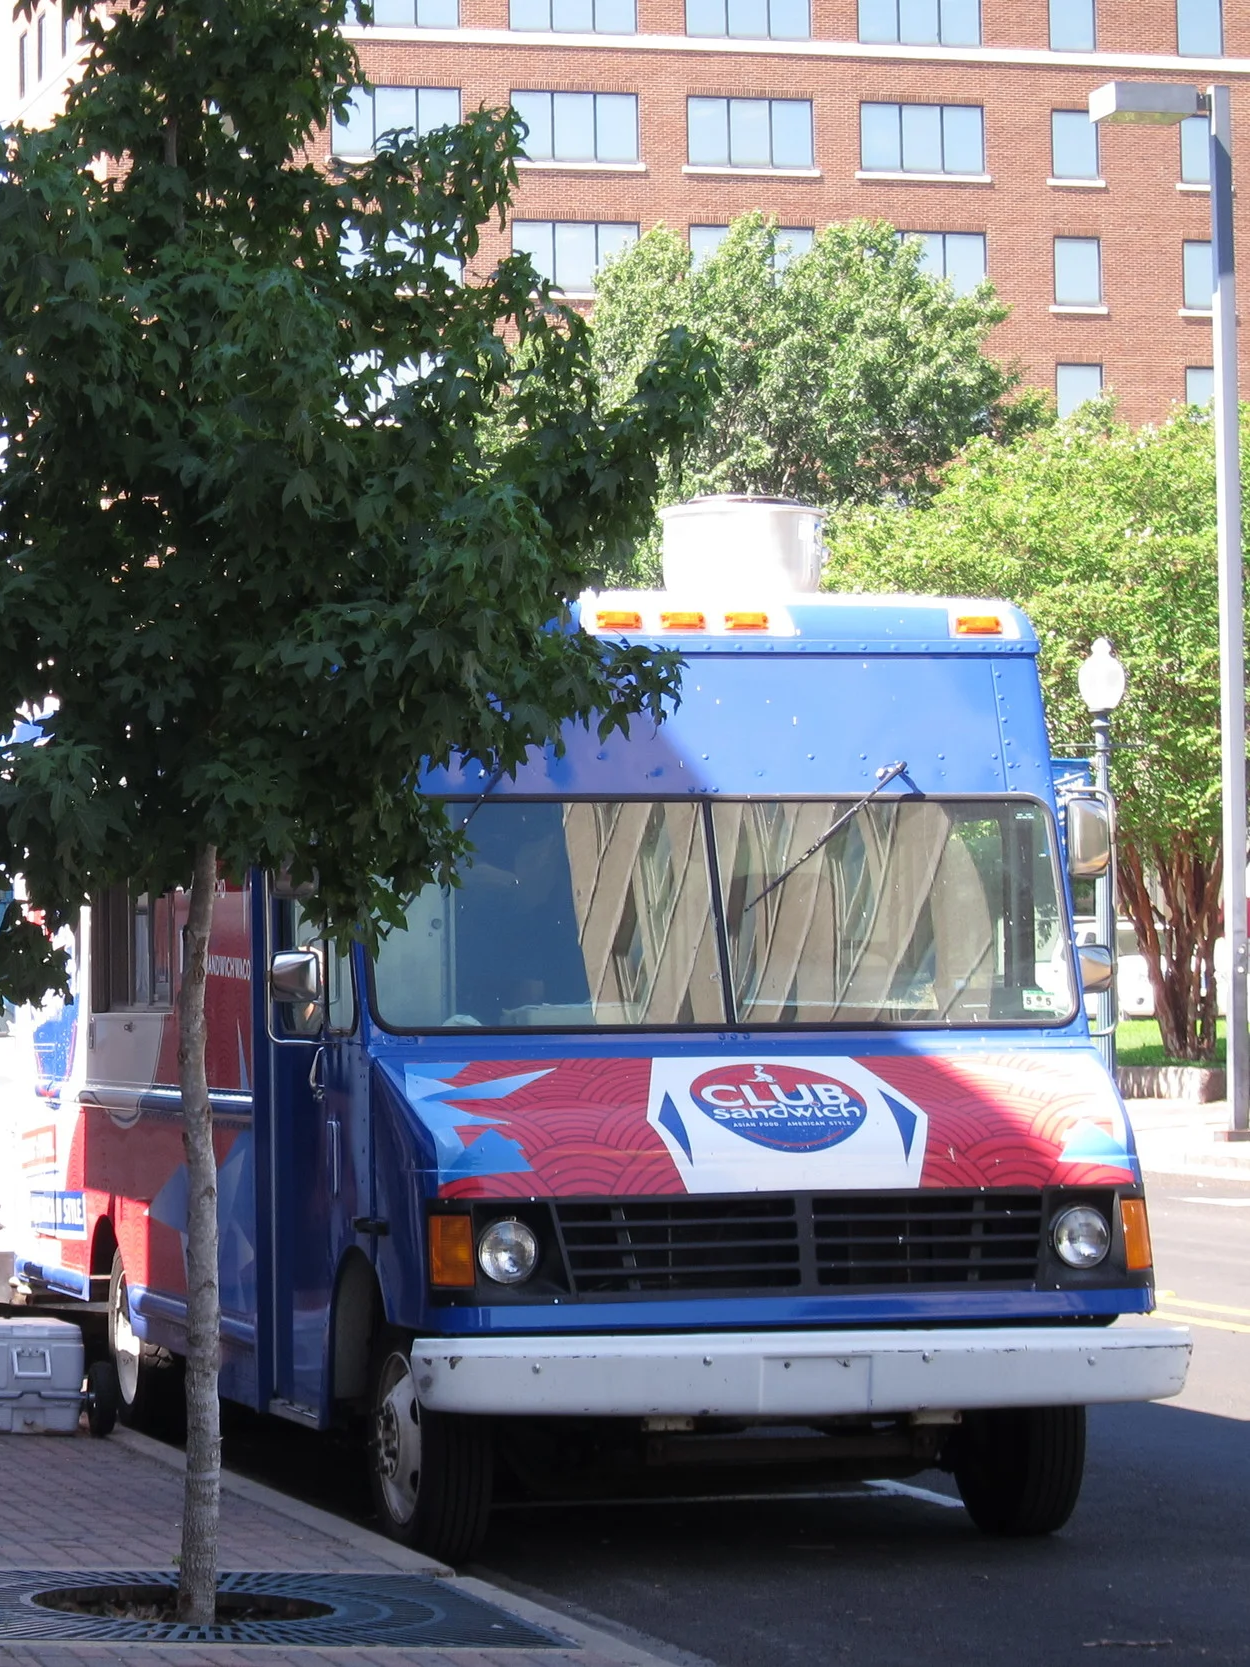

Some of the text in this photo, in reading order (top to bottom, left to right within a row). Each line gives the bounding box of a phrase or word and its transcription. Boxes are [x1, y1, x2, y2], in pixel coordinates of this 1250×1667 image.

[1026, 996, 1052, 1006] 5 5
[701, 1083, 850, 1107] CLUB
[713, 1102, 861, 1120] sandwich
